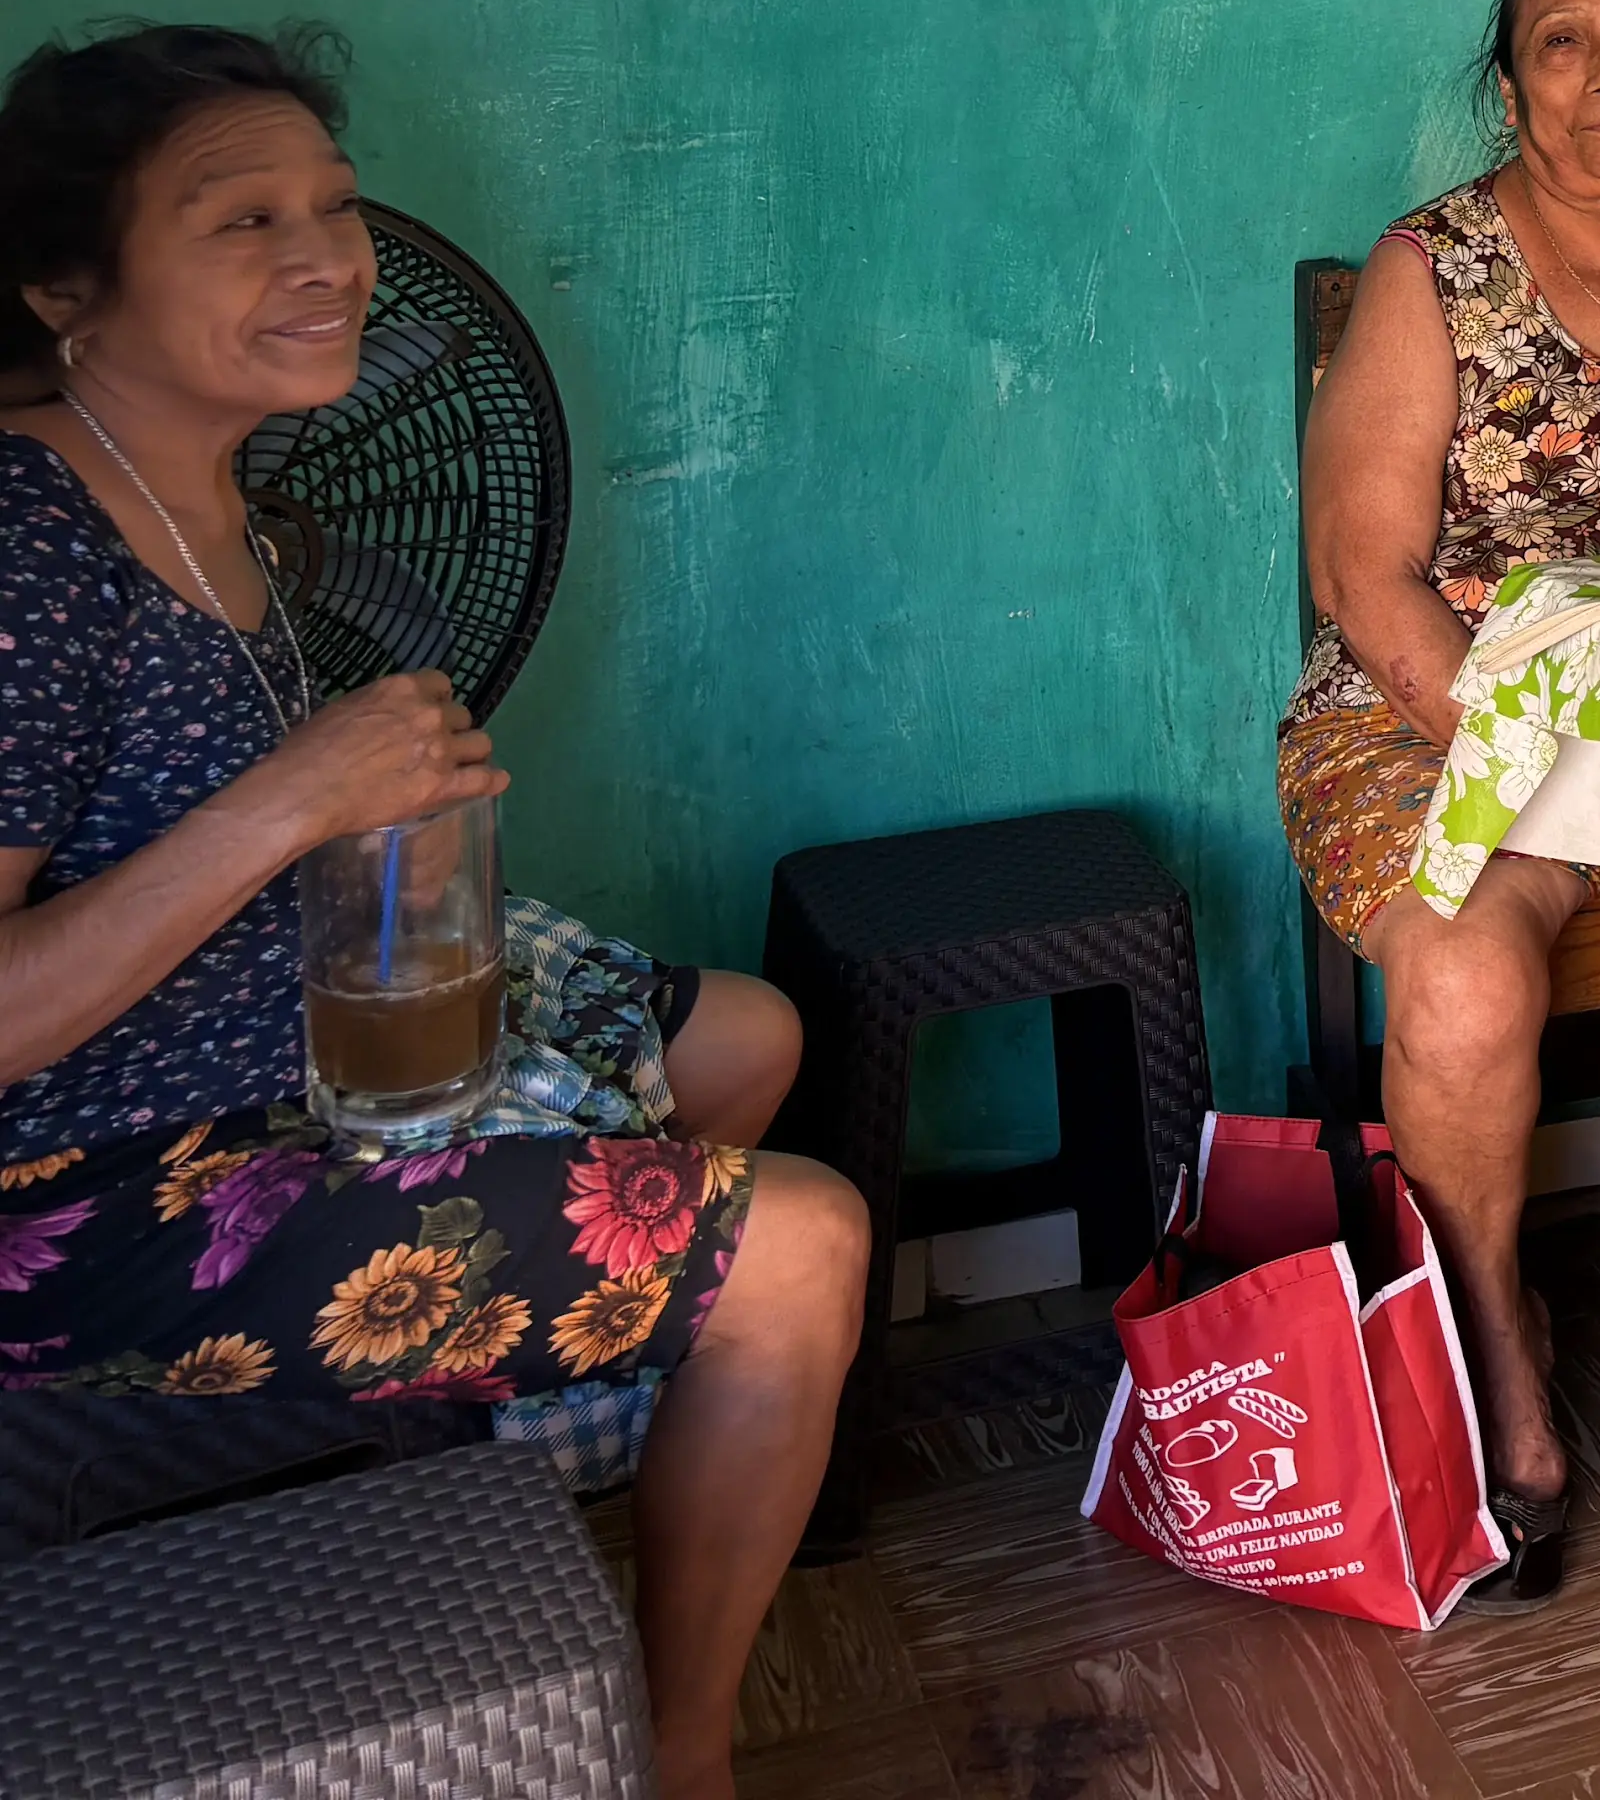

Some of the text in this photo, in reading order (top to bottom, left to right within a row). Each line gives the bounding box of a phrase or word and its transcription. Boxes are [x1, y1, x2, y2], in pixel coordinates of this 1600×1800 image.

[1141, 1358, 1273, 1421] BAUTISTA
[1196, 1516, 1272, 1547] BRINDADA
[1273, 1499, 1343, 1528] DURANTE
[1204, 1544, 1239, 1563] UNA
[1240, 1535, 1279, 1556] FELIZ
[1278, 1521, 1345, 1547] NAVIDAD
[1228, 1557, 1276, 1576] NUEVO
[1304, 1569, 1329, 1584] 532
[1329, 1566, 1346, 1580] 70
